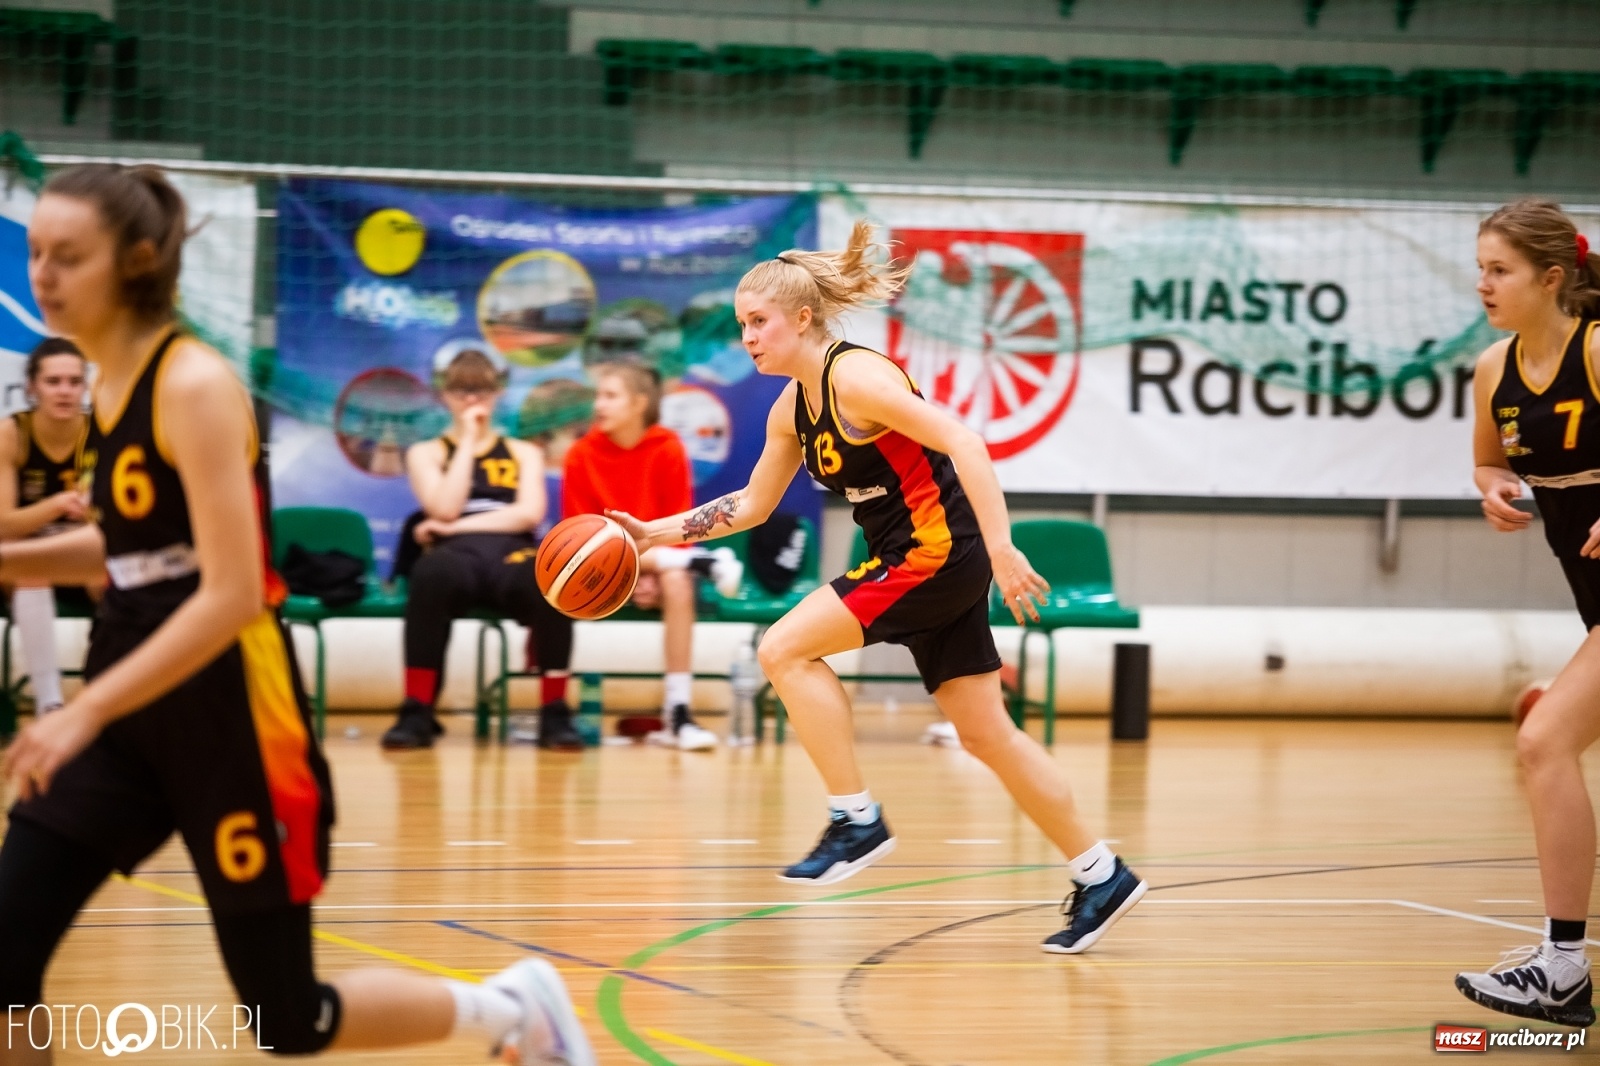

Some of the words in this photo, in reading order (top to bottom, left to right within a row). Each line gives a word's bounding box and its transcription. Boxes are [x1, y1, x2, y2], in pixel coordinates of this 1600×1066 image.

[1132, 278, 1347, 325] MIASTO
[1129, 337, 1475, 419] Racibór
[1554, 399, 1584, 450] 7
[482, 458, 519, 489] 12
[814, 431, 843, 476] 13
[111, 443, 156, 521] 6
[215, 810, 267, 882] 6
